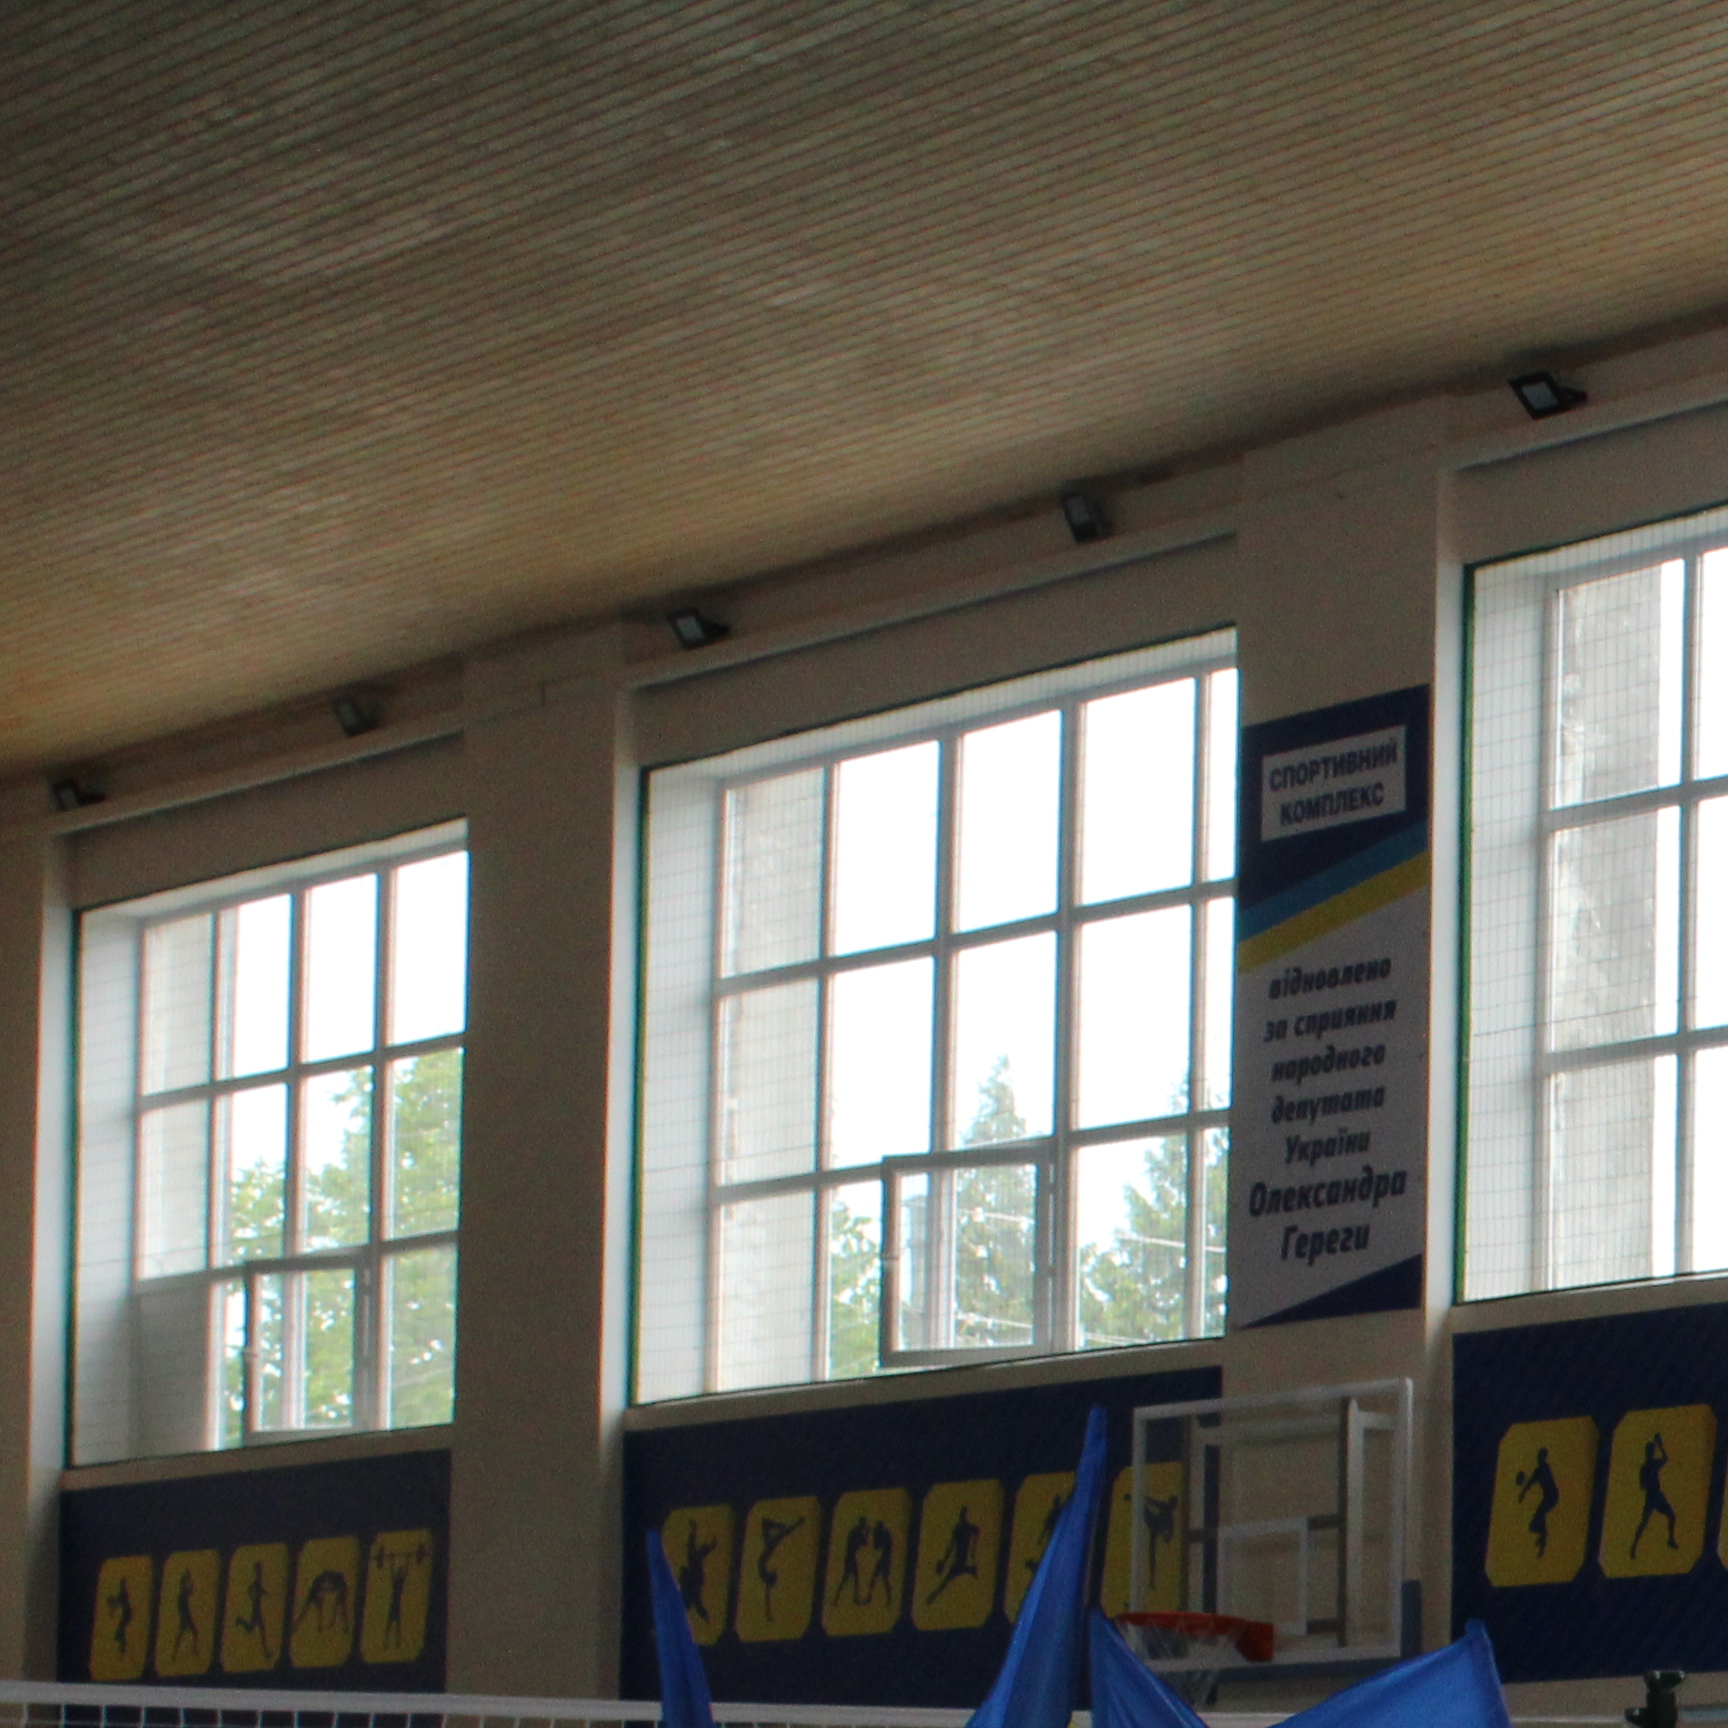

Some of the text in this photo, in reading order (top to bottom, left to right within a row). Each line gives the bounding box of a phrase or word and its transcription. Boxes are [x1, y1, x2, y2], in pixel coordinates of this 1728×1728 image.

[1269, 736, 1397, 792] СПОРТИВНИЙ
[1279, 781, 1385, 826] КОМПЛЕКС
[1268, 957, 1392, 1000] відновлено
[1263, 1000, 1397, 1043] за сприяння
[1271, 1043, 1386, 1085] народного
[1271, 1086, 1386, 1127] депутата
[1284, 1127, 1371, 1167] України
[1249, 1163, 1407, 1216] Олександра
[1280, 1224, 1370, 1267] Гереги
